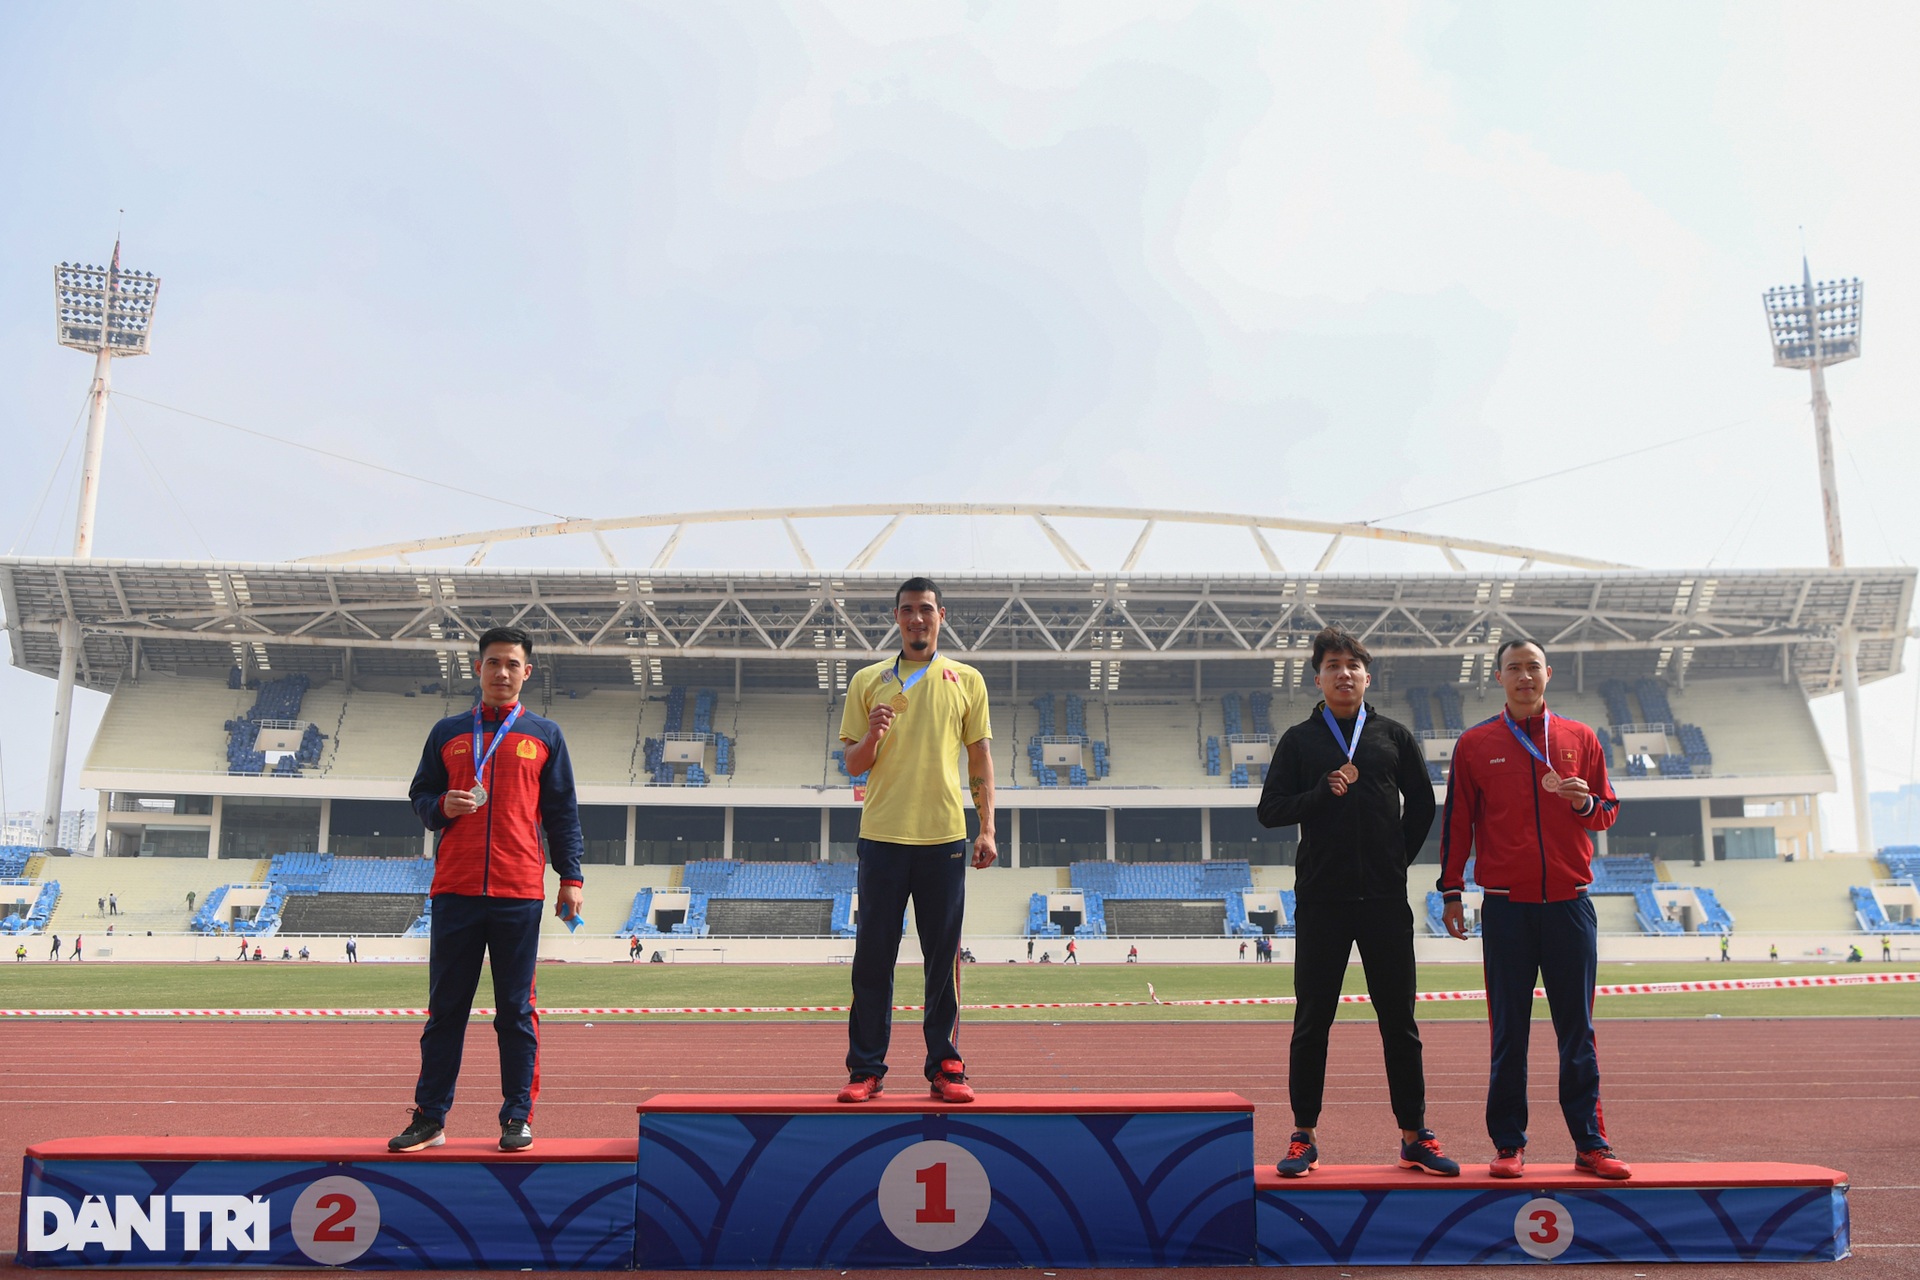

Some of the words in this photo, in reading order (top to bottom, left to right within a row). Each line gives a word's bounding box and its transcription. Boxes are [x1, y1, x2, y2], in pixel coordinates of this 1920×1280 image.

[916, 1162, 956, 1223] 1
[313, 1193, 357, 1242] 2
[1529, 1210, 1559, 1244] 3
